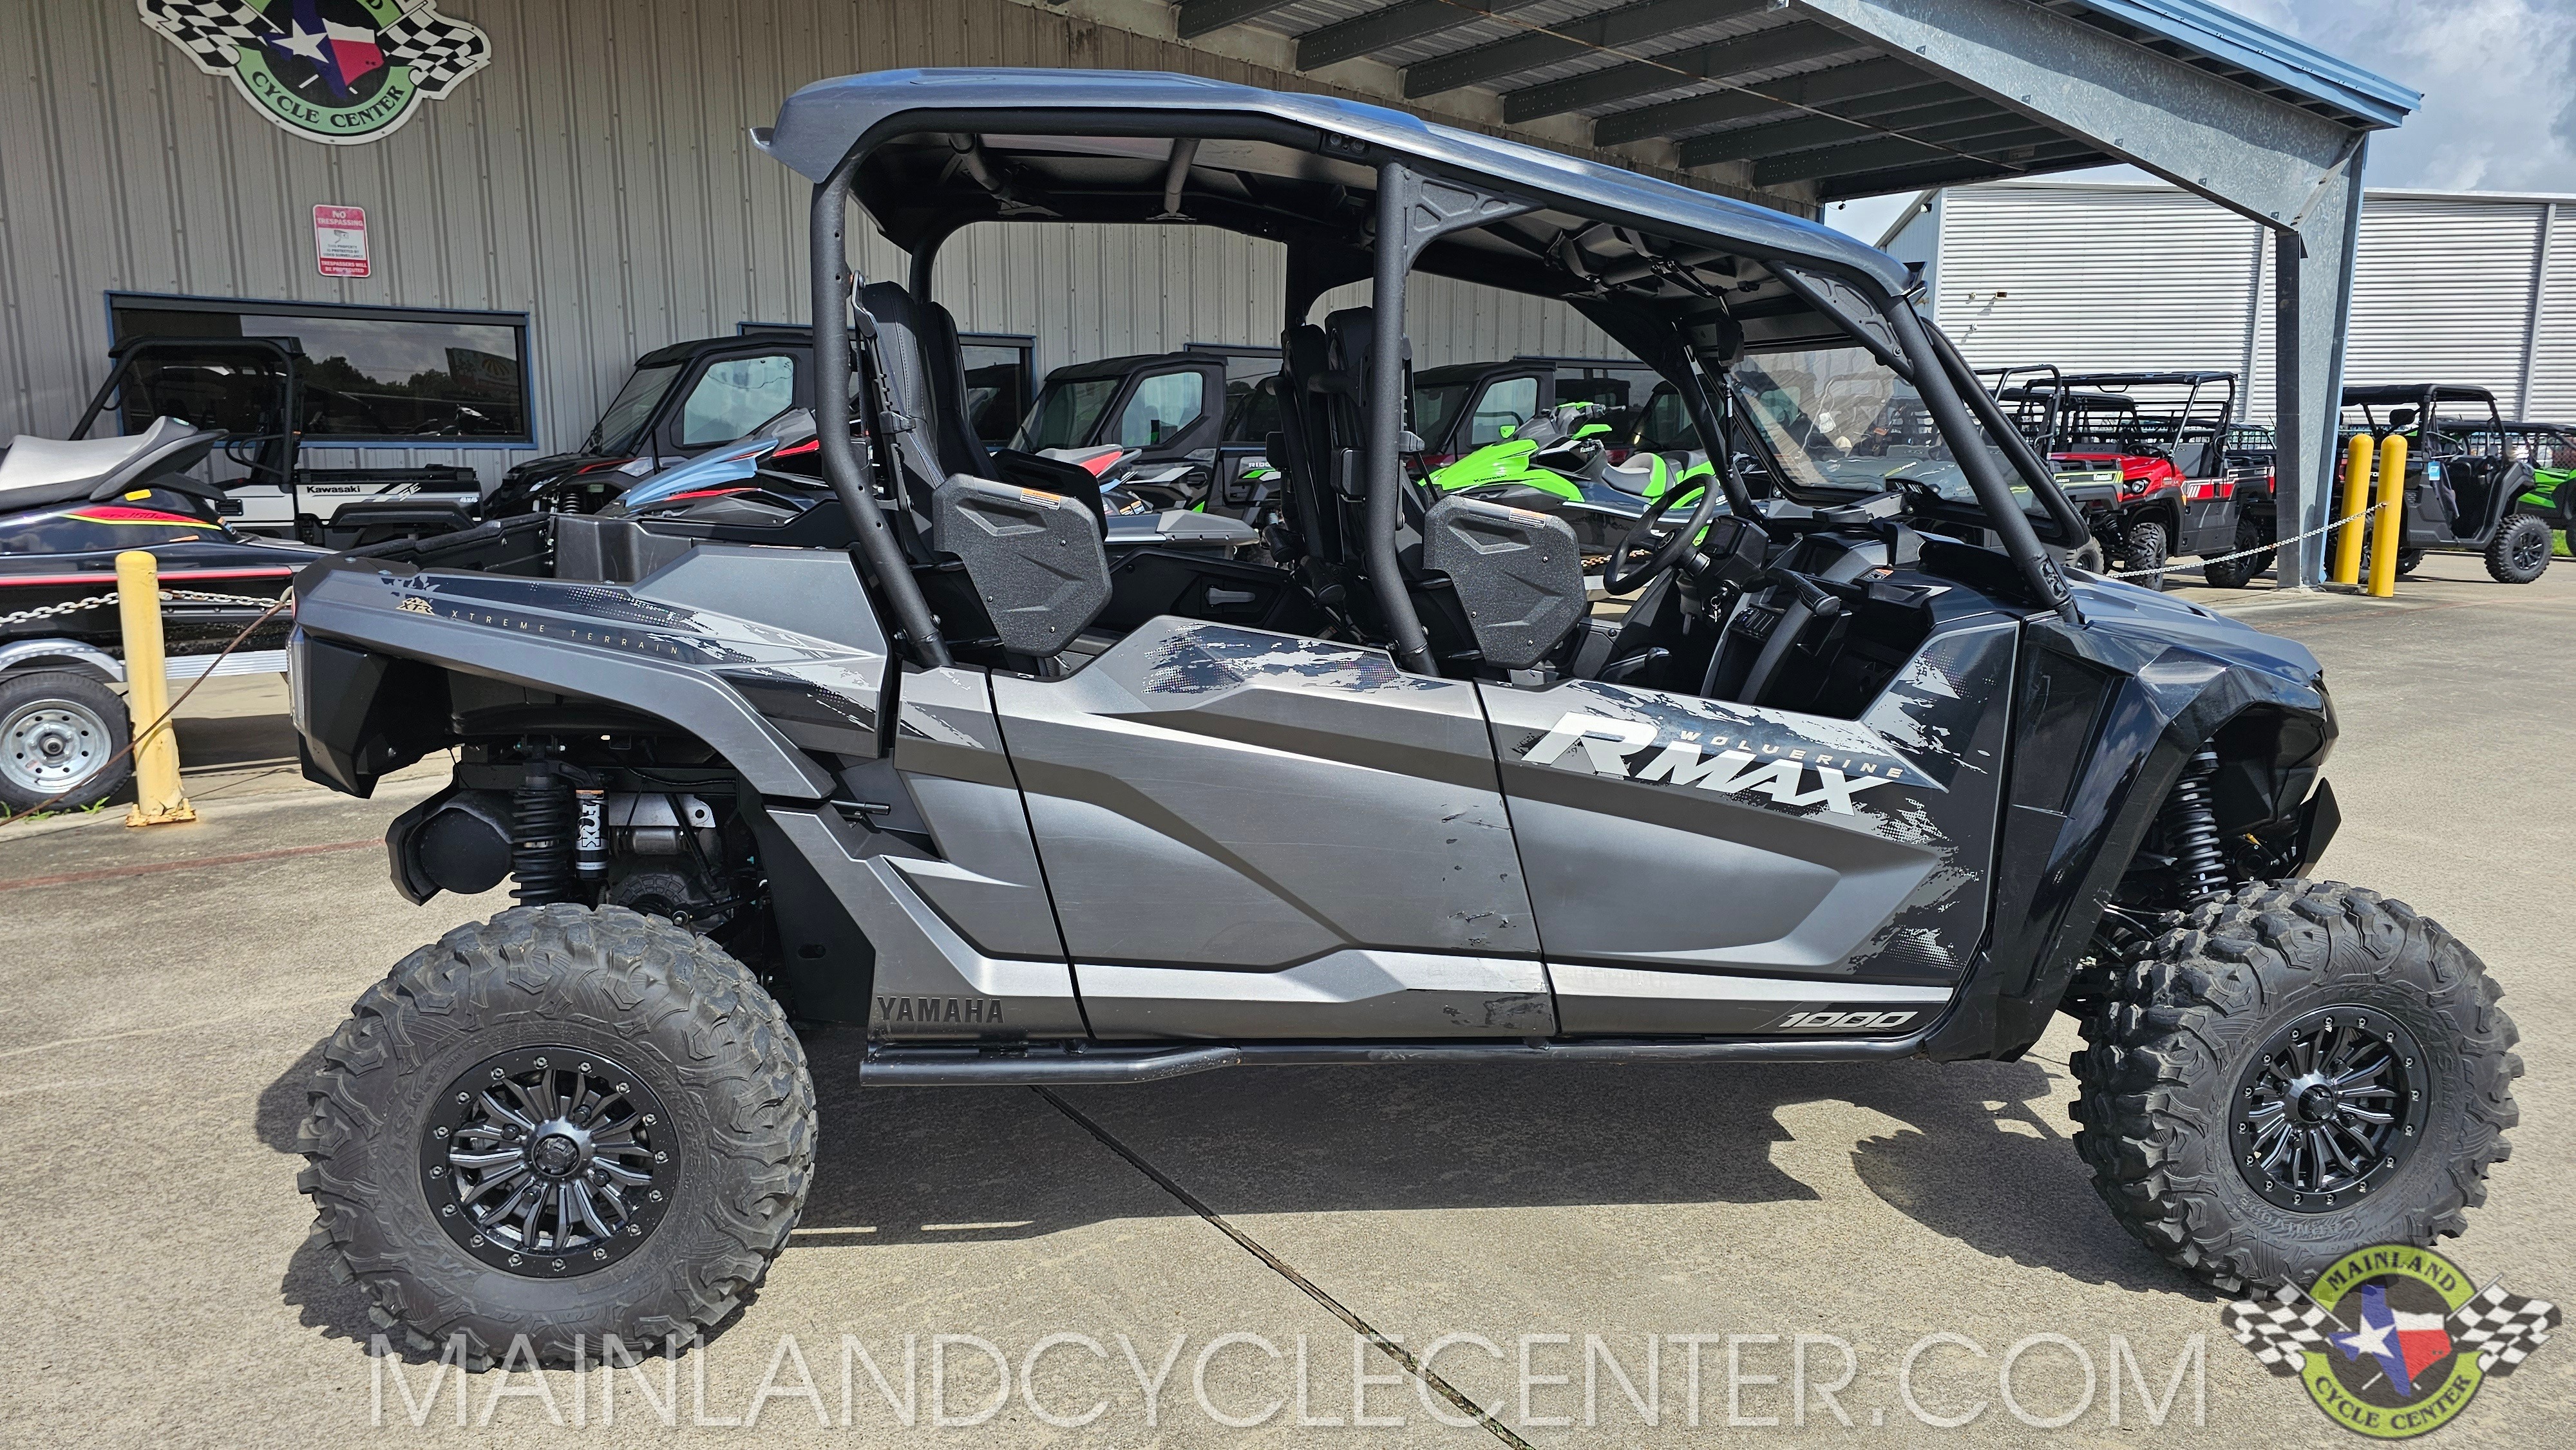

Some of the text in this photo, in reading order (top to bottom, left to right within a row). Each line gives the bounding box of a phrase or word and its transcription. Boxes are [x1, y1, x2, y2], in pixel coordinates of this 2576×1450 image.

[252, 71, 405, 127] CYCLE CENTER
[317, 217, 364, 227] TRESPASSING
[332, 211, 346, 219] NO
[307, 483, 422, 502] Kawasaki SE
[451, 610, 545, 632] XTREME
[571, 630, 678, 654] TERRAIN
[1520, 711, 1893, 816] RMAX
[1679, 730, 1904, 778] WOLVERINE
[578, 804, 601, 847] FOX
[876, 996, 1005, 1023] YAMAHA
[1778, 1011, 1918, 1028] 1000
[2233, 1192, 2362, 1238] CARNIVORE
